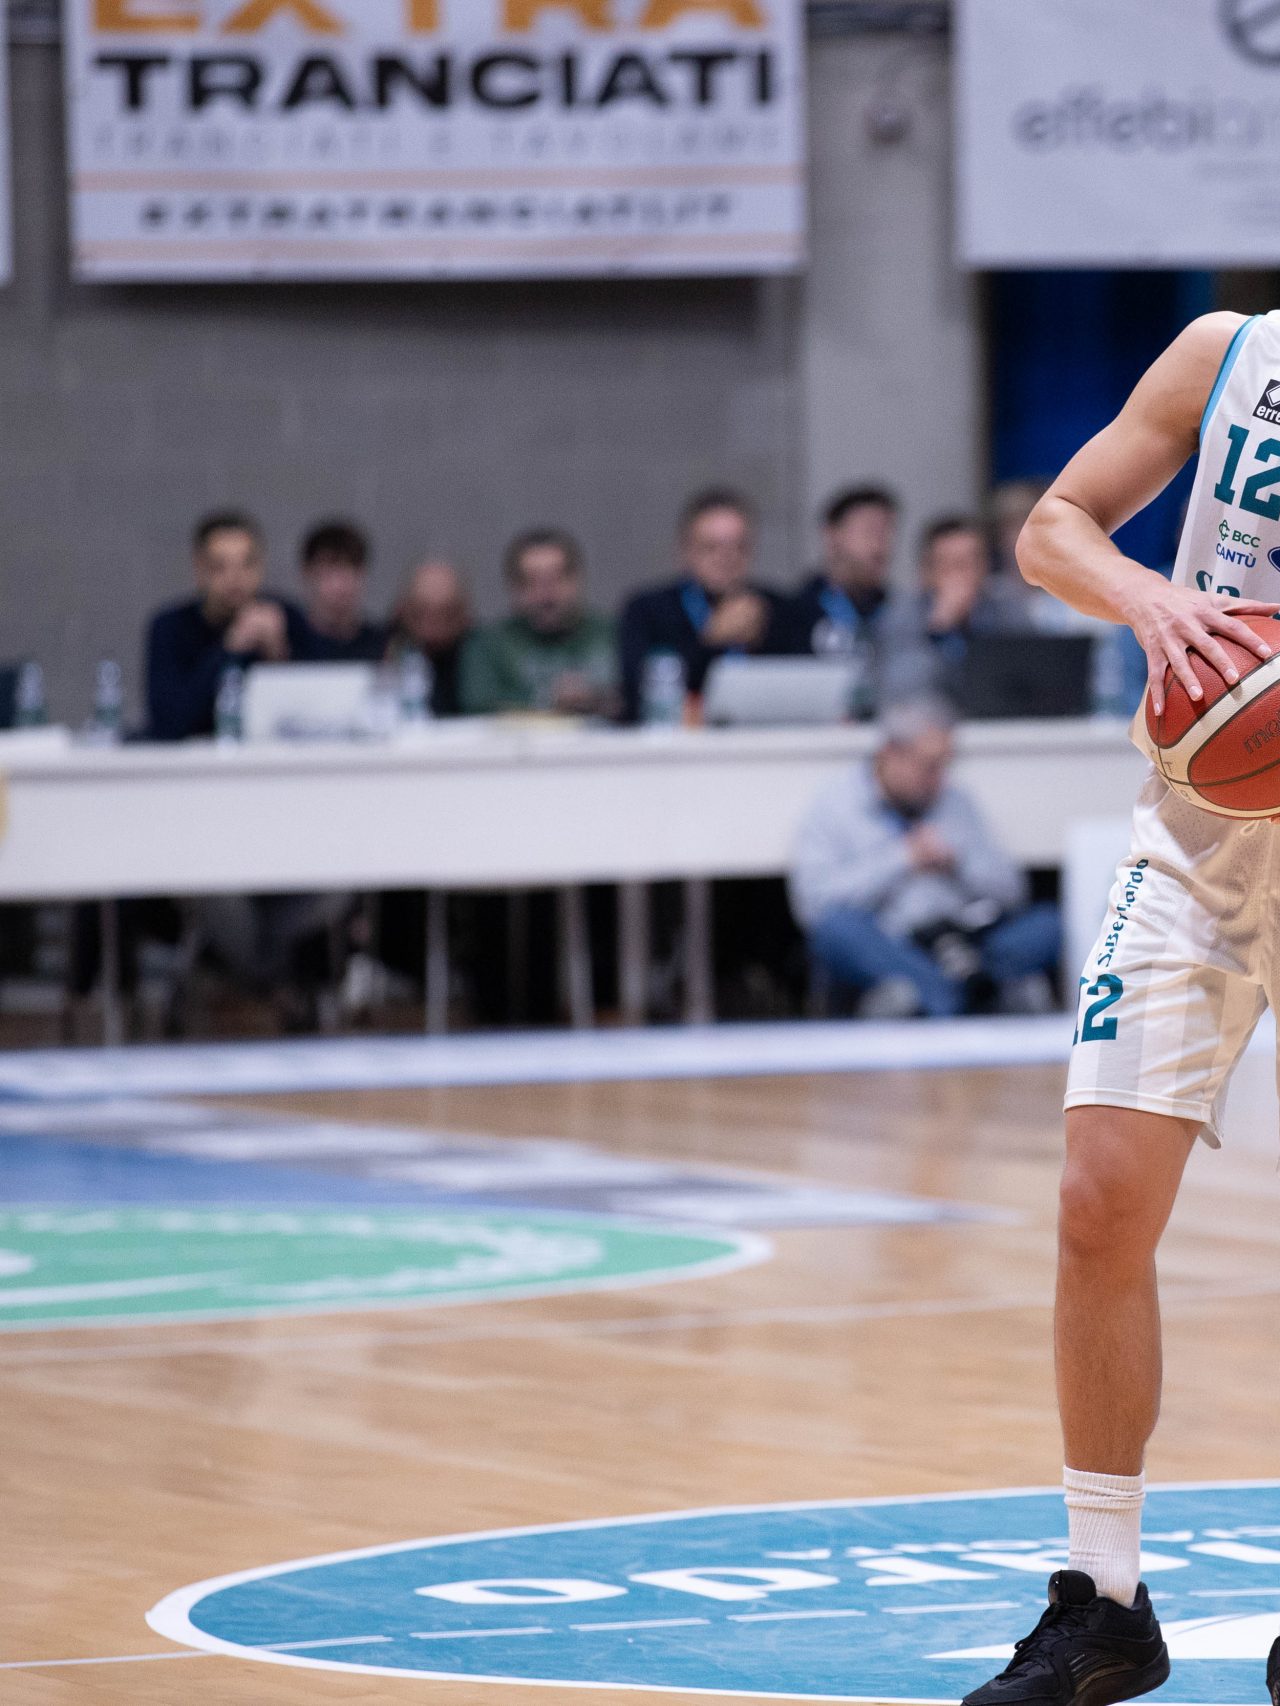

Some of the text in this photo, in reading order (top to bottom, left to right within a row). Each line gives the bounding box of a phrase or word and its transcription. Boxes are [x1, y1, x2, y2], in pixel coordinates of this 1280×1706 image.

[93, 50, 774, 110] TRANCIATI
[1216, 543, 1257, 568] CANTÙ
[1232, 530, 1260, 548] BCC
[1072, 973, 1124, 1047] 2
